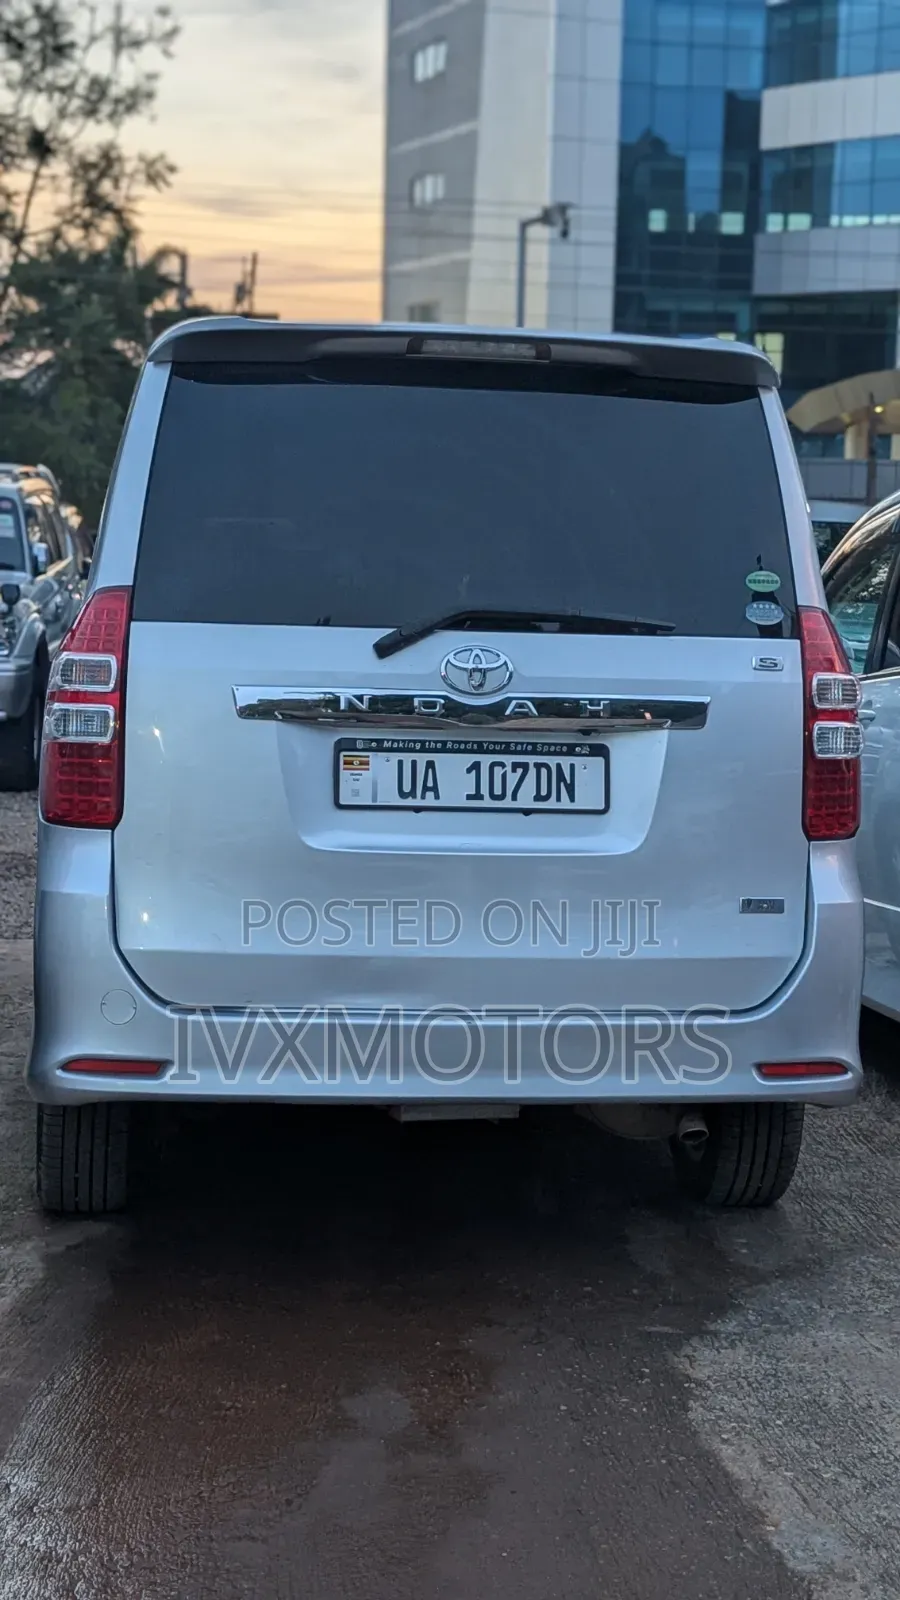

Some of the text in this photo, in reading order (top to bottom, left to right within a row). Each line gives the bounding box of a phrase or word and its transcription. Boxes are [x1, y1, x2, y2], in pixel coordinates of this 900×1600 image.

[758, 657, 779, 669] S
[338, 694, 611, 717] NOAH
[383, 740, 568, 753] Making the Roads Your Safe Space
[397, 759, 576, 803] UA 107DN
